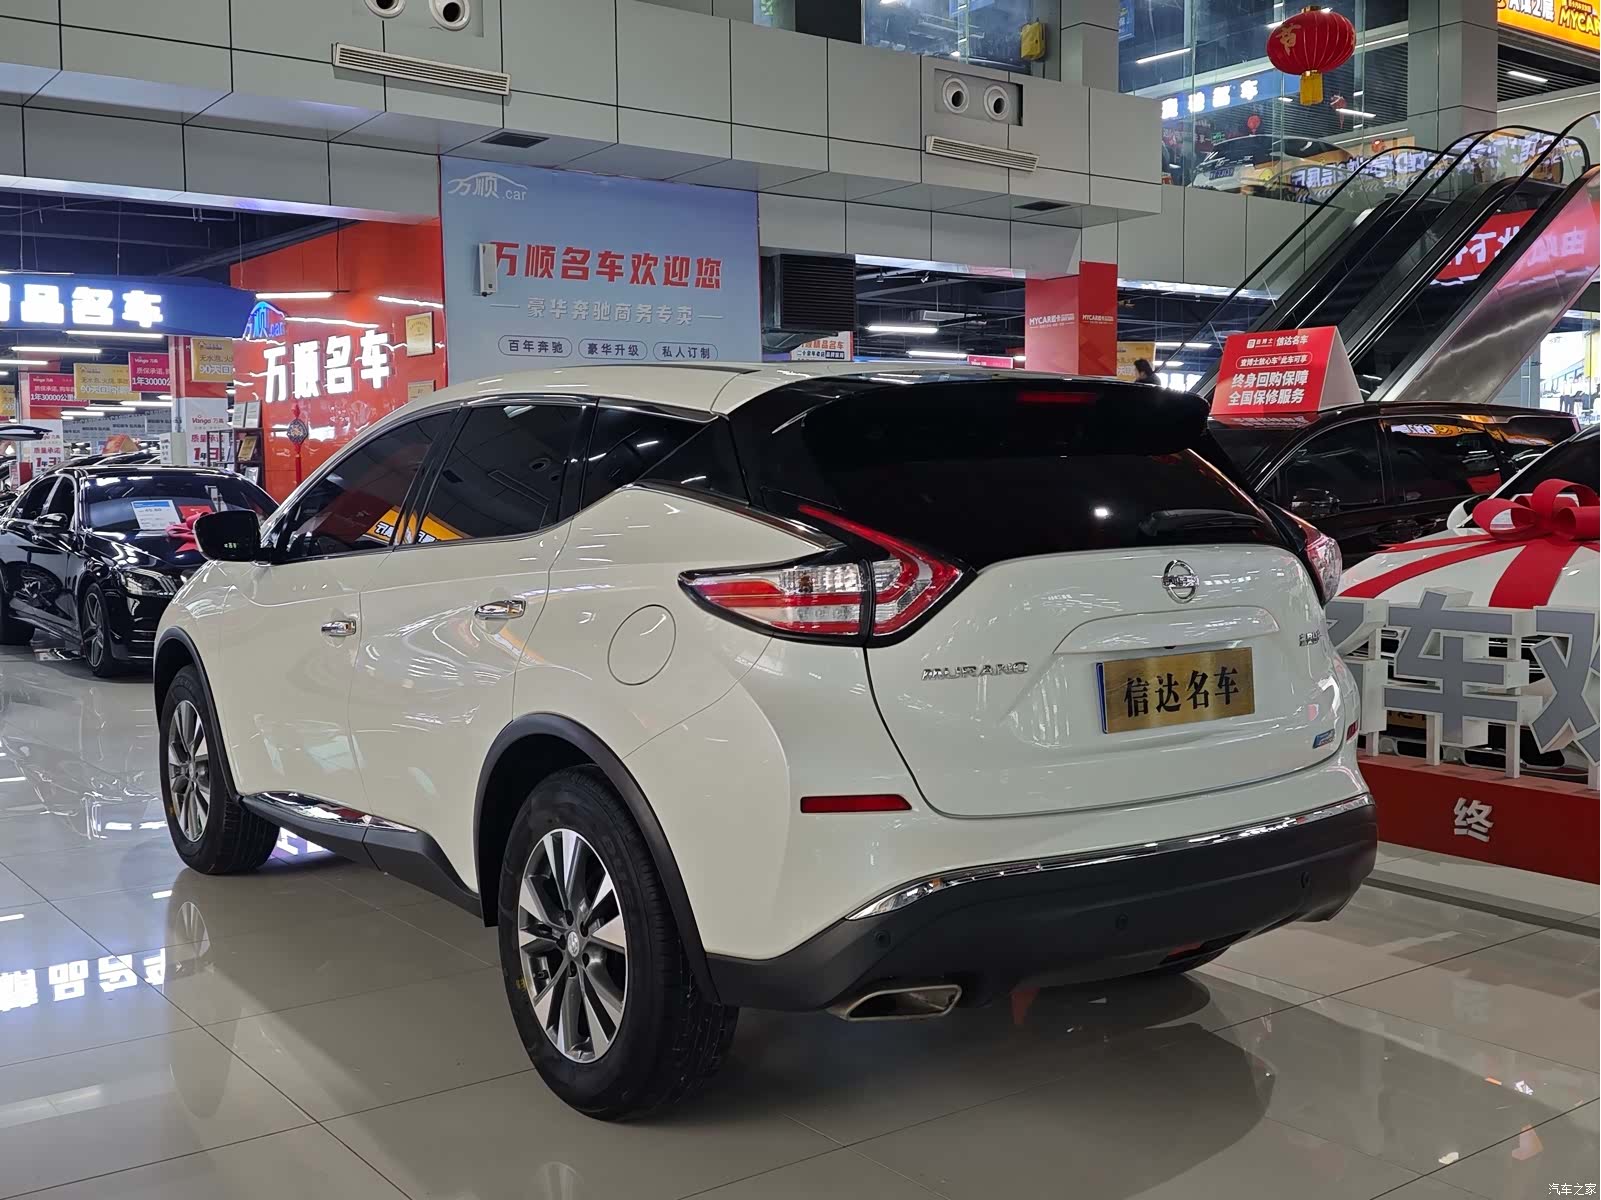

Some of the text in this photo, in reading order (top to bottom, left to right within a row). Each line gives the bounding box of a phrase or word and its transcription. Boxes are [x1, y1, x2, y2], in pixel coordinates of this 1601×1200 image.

[489, 241, 723, 289] 万顺名车欢迎您
[0, 283, 164, 328] 品名车
[527, 297, 694, 325] 豪华奔驰商务专卖
[507, 339, 563, 354] 百年奔驰
[587, 342, 639, 357] 豪华升级
[1276, 335, 1309, 347] 信达名车
[661, 345, 711, 359] 私人订制
[263, 329, 390, 403] 万顺名车
[1231, 370, 1309, 388] 终身回购保障
[1228, 388, 1305, 406] 全国保修服务
[921, 661, 1030, 681] MURANO
[1124, 666, 1240, 718] 信达名车
[1453, 797, 1494, 842] 终
